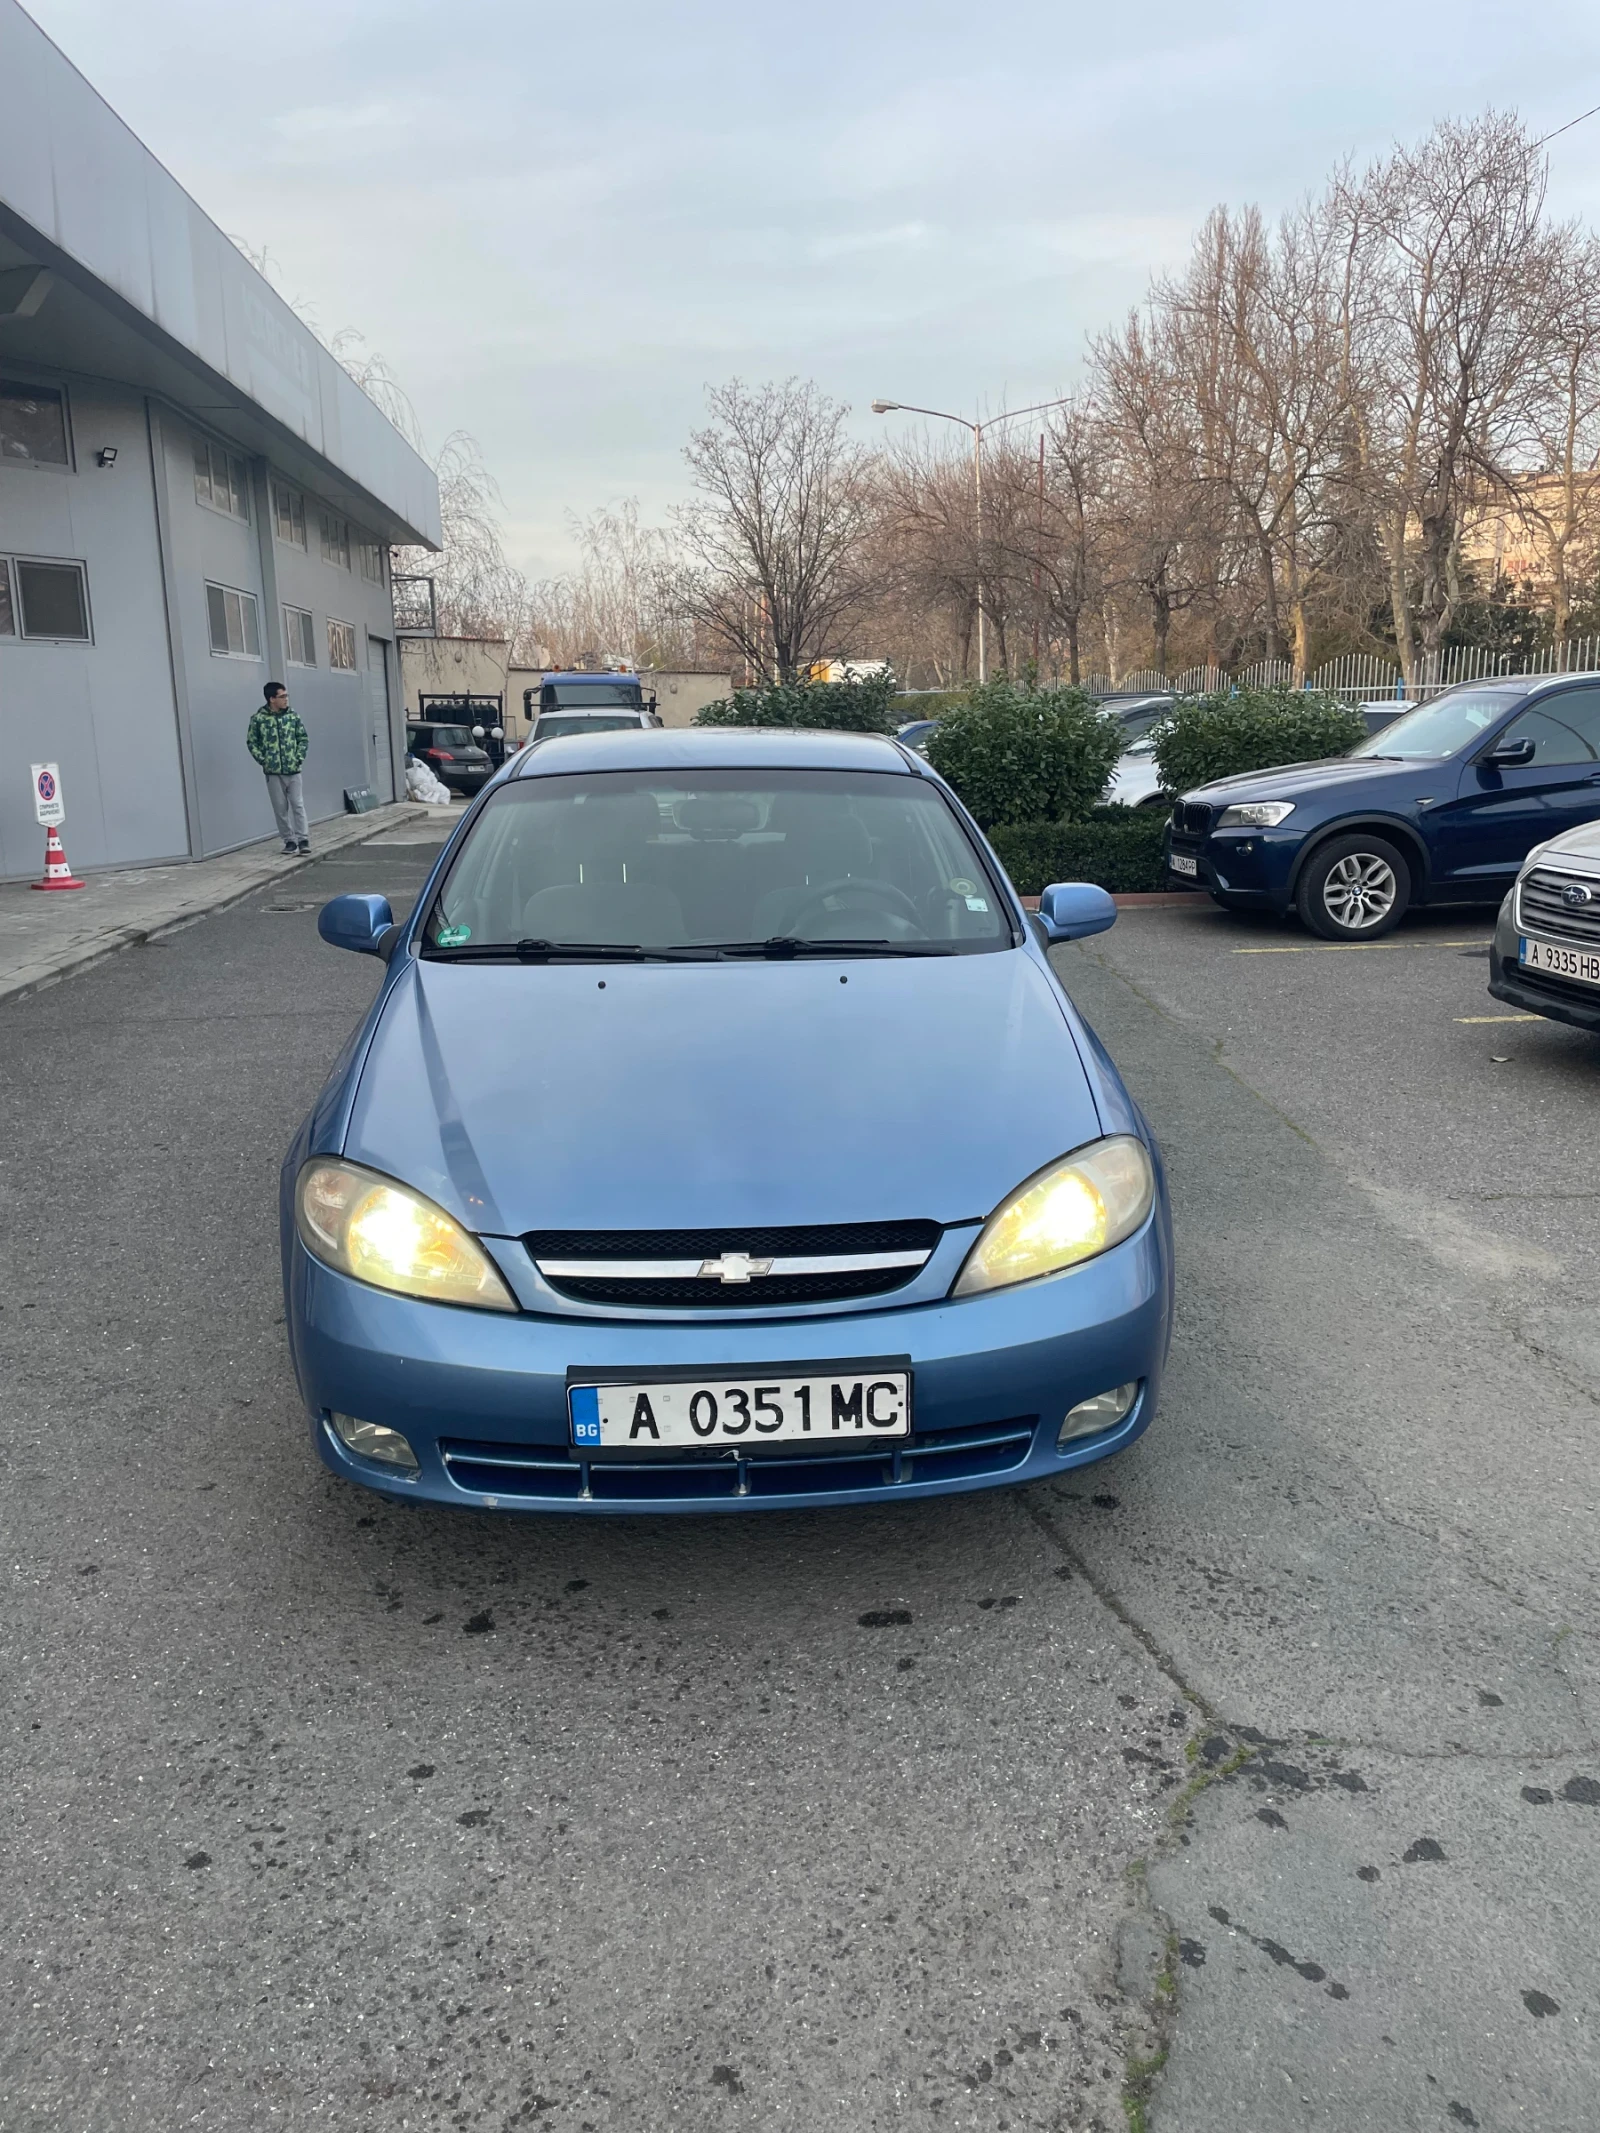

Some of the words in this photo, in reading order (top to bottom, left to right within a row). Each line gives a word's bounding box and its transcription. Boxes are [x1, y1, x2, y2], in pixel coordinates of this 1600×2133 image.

[1532, 944, 1539, 964] A
[1546, 948, 1577, 974] 9335
[1580, 956, 1600, 979] HB
[629, 1393, 660, 1439] A
[689, 1385, 812, 1437] 0351
[831, 1381, 898, 1430] MC
[576, 1424, 598, 1437] BG
